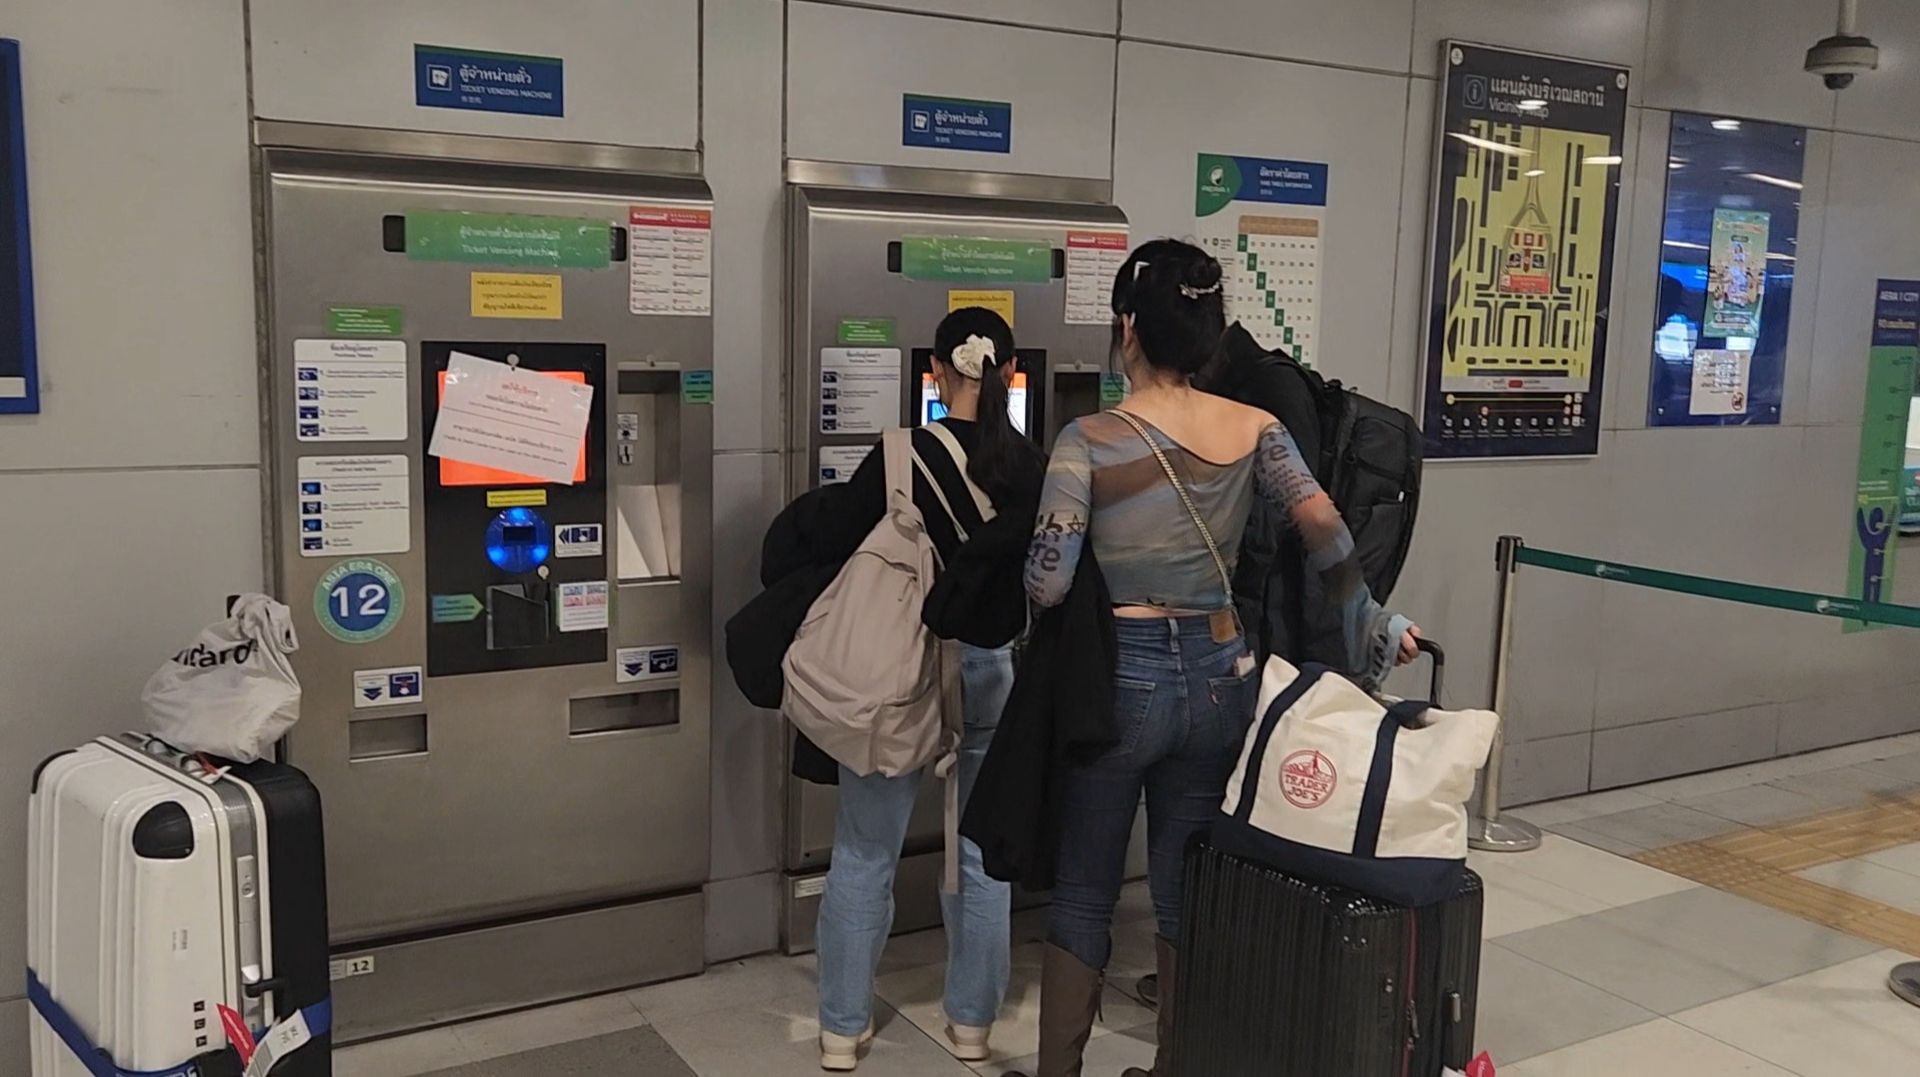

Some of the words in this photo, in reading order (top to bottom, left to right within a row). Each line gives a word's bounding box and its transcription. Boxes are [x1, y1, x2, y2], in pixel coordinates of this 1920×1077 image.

[330, 583, 387, 618] 12
[1285, 774, 1329, 794] TRADER
[352, 960, 370, 973] 12
